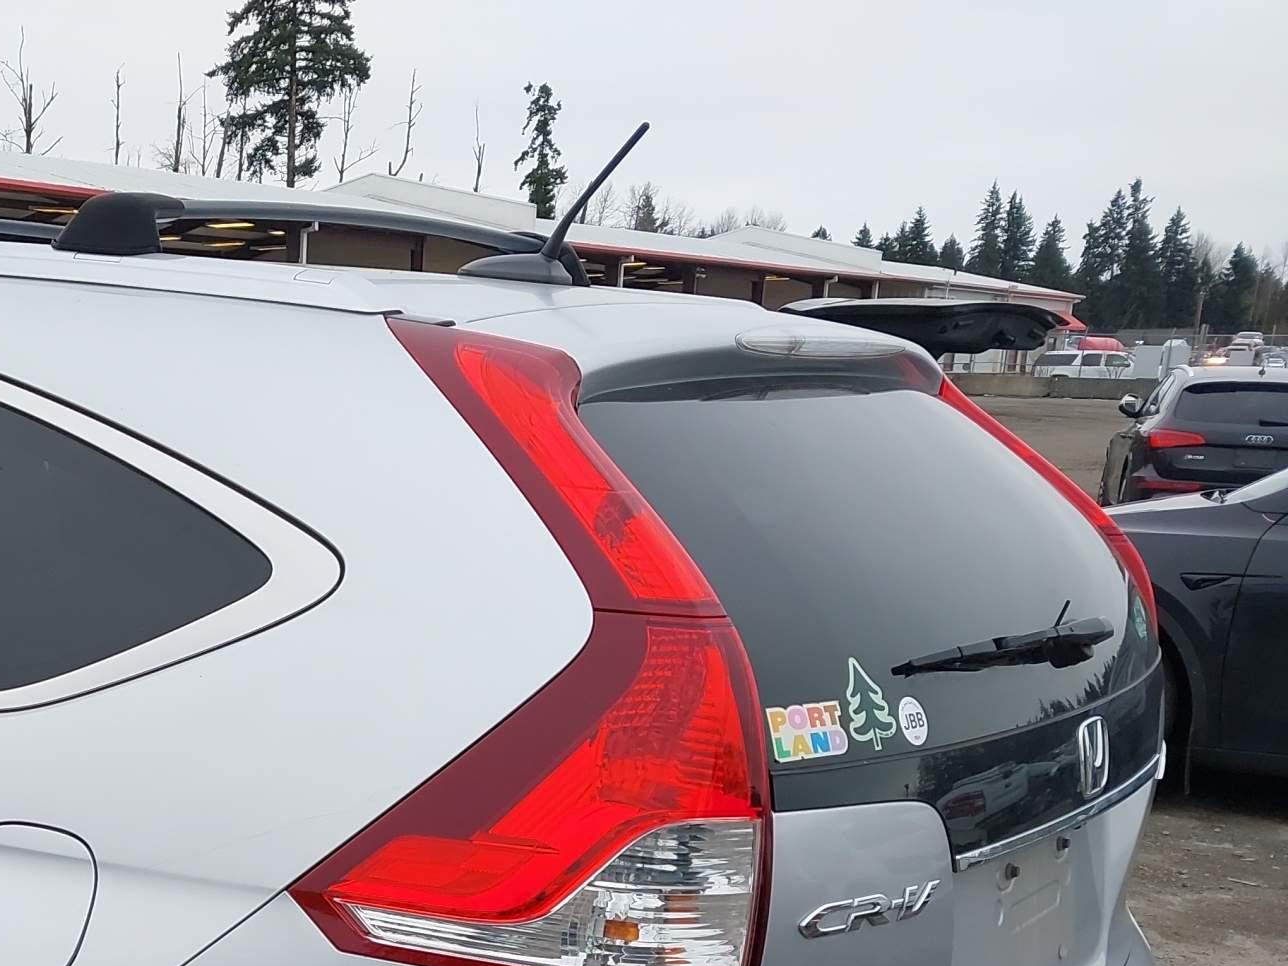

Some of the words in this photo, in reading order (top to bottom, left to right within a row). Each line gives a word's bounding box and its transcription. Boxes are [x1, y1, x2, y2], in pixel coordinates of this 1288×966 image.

[769, 704, 839, 733] PORT
[904, 711, 925, 731] JBB
[774, 730, 847, 759] LAND
[799, 880, 941, 939] CR-V
